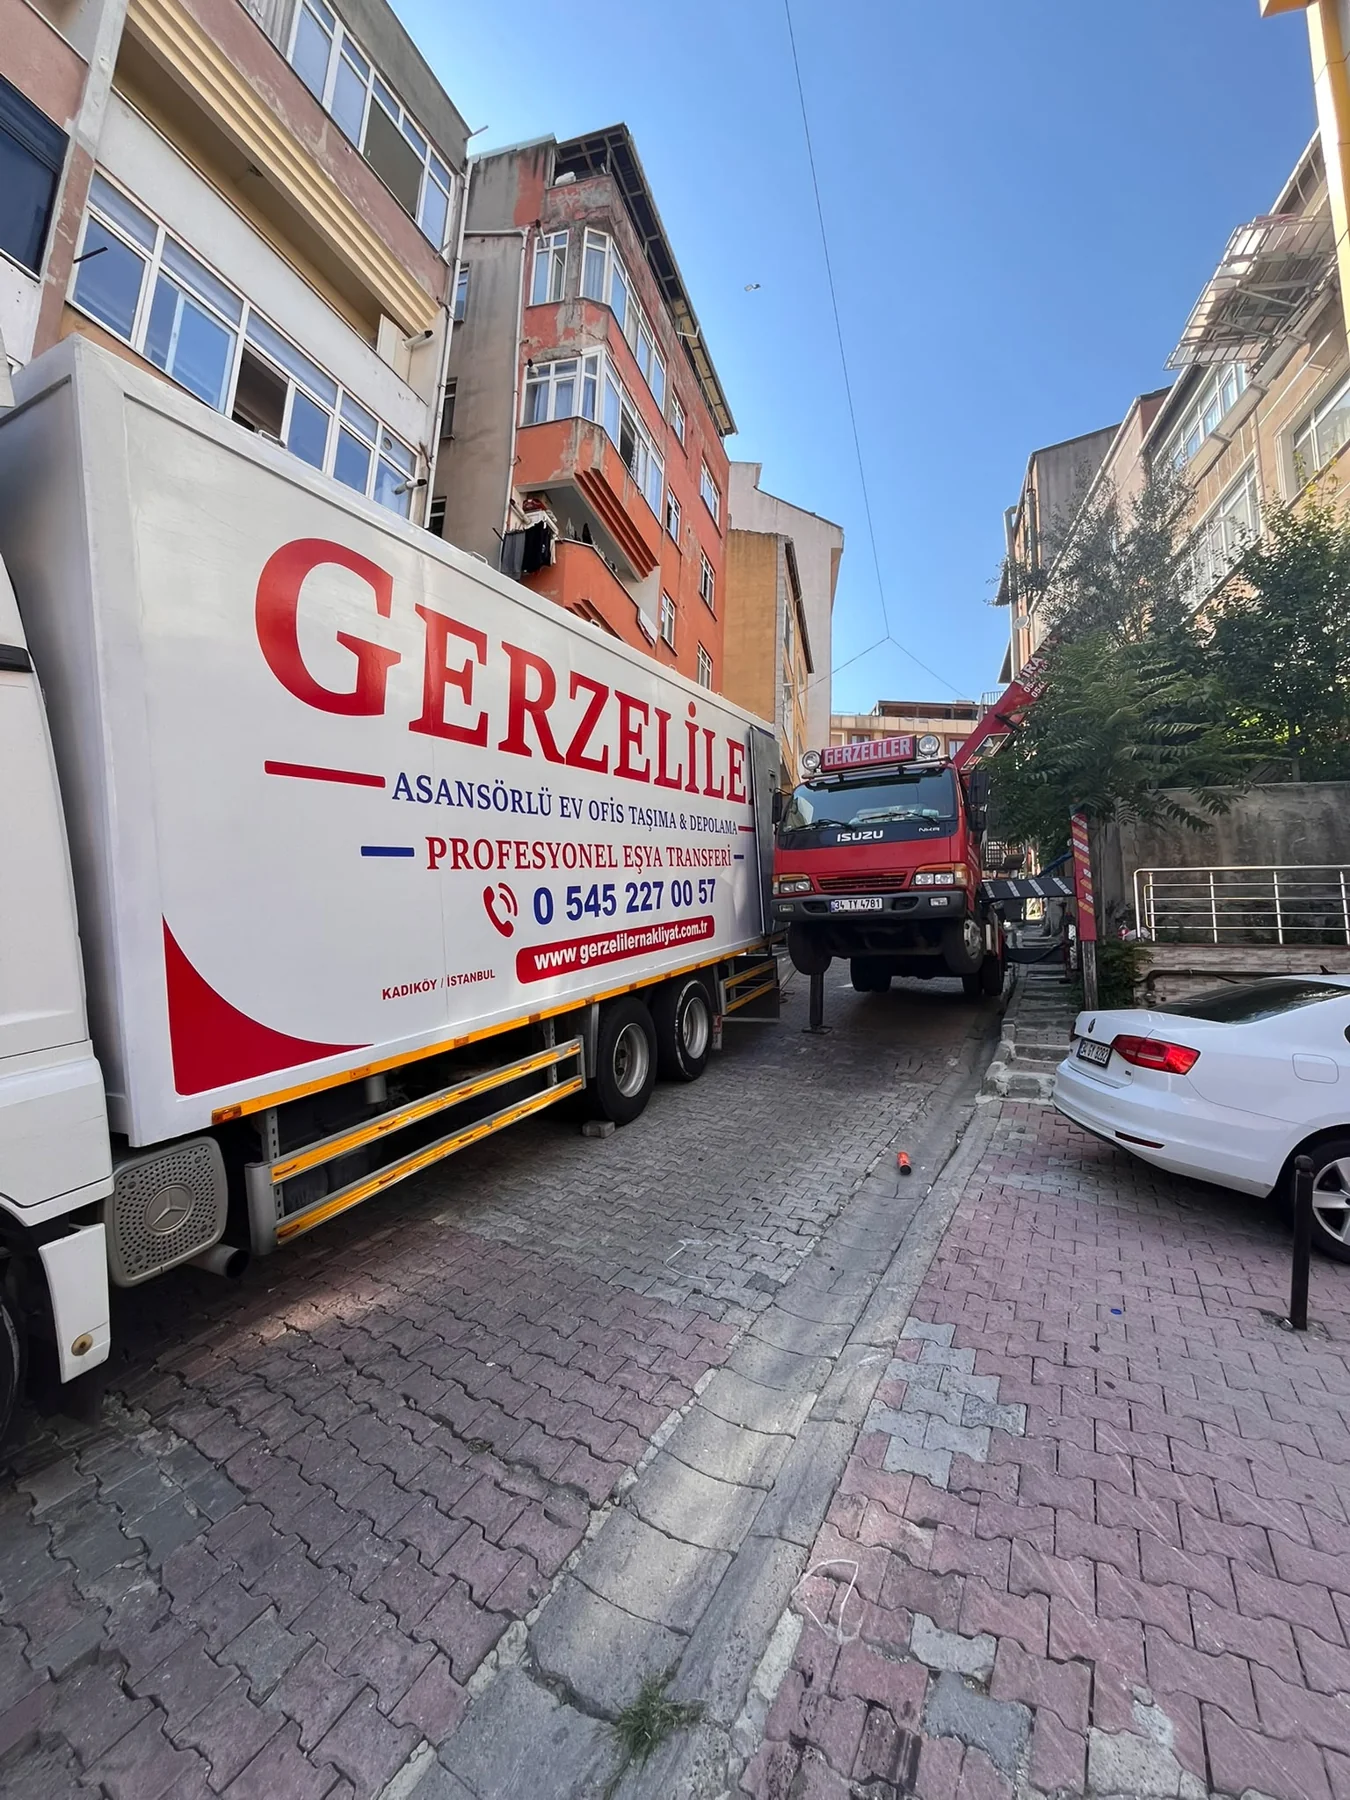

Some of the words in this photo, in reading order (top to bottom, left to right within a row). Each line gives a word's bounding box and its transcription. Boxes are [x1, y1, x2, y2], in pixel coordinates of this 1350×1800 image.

[255, 537, 753, 806] GERZELİLE
[392, 772, 552, 816] ASANSÖRLÜ
[559, 796, 583, 819] EV
[589, 797, 624, 823] OFİS
[628, 805, 677, 831] TAŞIMA
[680, 813, 687, 830] &
[690, 814, 738, 835] DEPOLAMA
[425, 836, 618, 870] PROFESYONEL
[623, 845, 663, 874] EŞYA
[666, 844, 732, 867] TRANSFERİ
[837, 830, 884, 843] ISUZU
[533, 887, 554, 925] 0
[566, 883, 617, 921] 545
[625, 881, 664, 914] 227
[671, 879, 693, 907] 00
[698, 878, 716, 904] 57
[835, 900, 845, 909] 34
[849, 900, 858, 909] TY
[860, 899, 880, 908] 4781
[382, 978, 437, 1000] KADIKÖY
[447, 969, 496, 987] İSTANBUL
